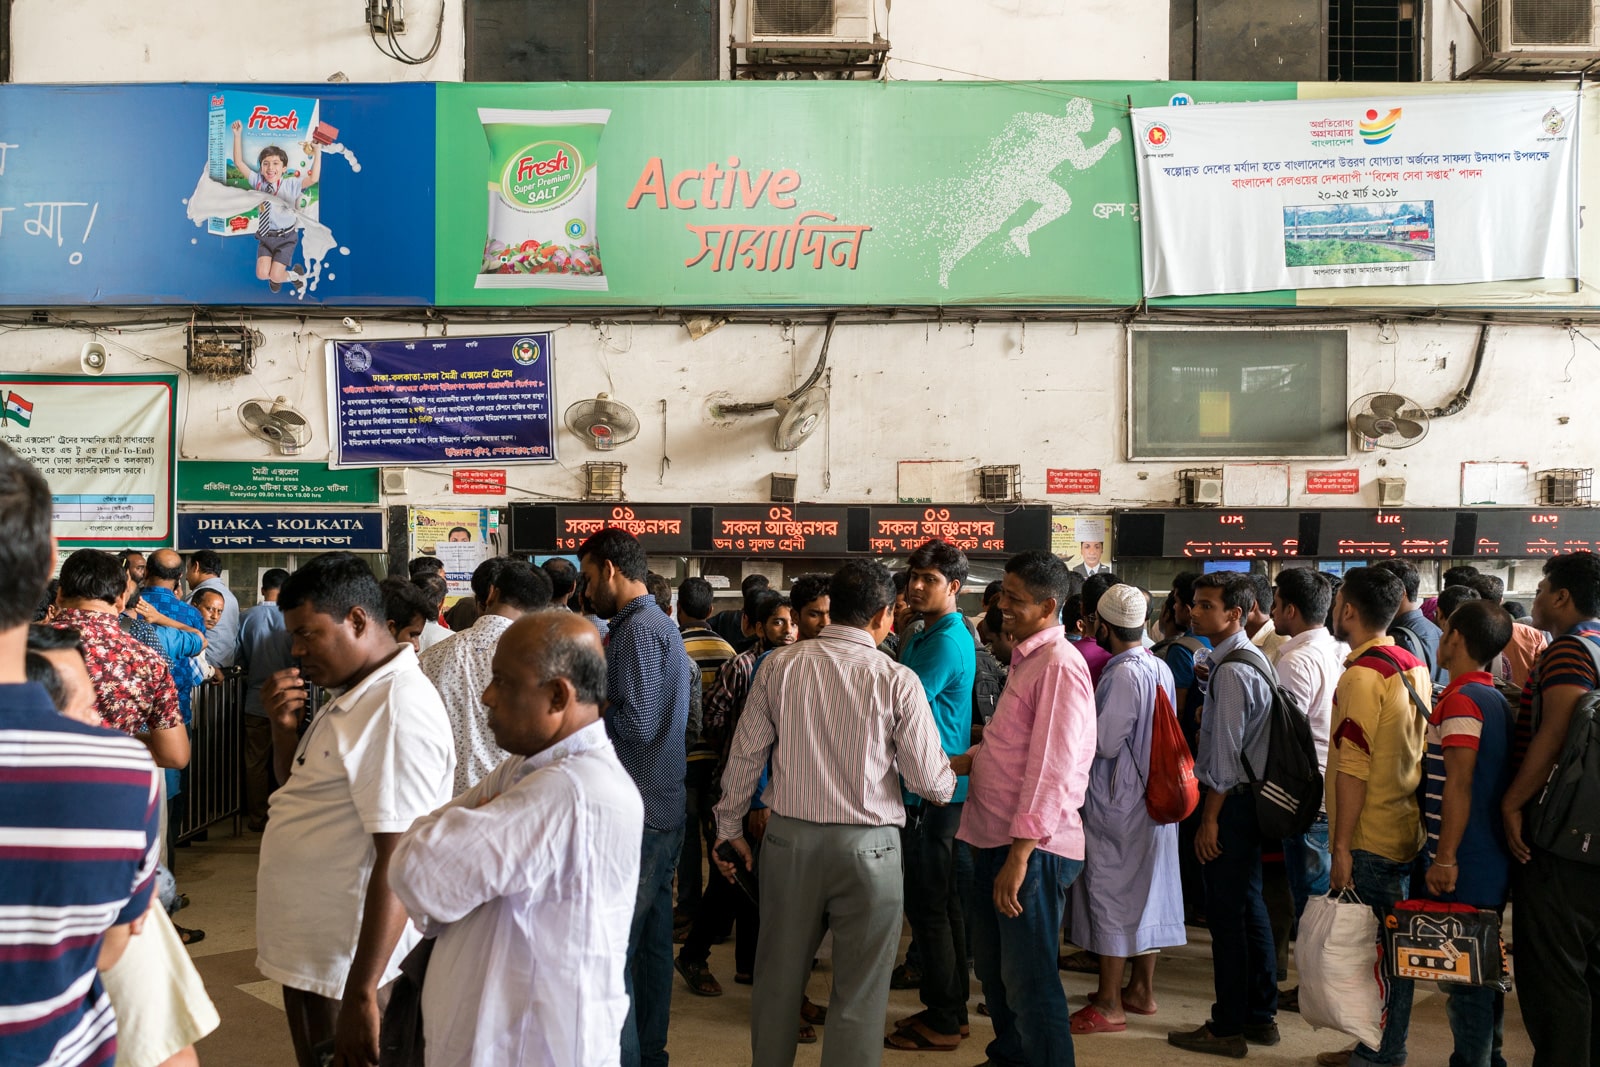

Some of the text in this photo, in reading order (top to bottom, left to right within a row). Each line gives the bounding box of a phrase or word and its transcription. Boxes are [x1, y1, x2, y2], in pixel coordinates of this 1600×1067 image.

[248, 105, 299, 131] Fresh
[1311, 138, 1354, 148] বাংলাদেশ
[517, 149, 568, 182] Fresh
[1203, 164, 1230, 175] দেশের
[1234, 161, 1259, 173] মর্যাদা
[1263, 161, 1281, 172] হতে
[1284, 159, 1335, 171] বাংলাদেশের
[1339, 157, 1365, 169] উত্তরণ
[1370, 156, 1403, 167] যোগ্যতা
[1407, 152, 1439, 165] অর্জনের
[1443, 154, 1471, 164] সাফল্য
[1474, 152, 1511, 163] উদযাপন
[1514, 150, 1550, 162] উপলক্ষে
[514, 174, 570, 194] Super Premium
[626, 155, 800, 209] Active
[1232, 177, 1273, 189] বাংলাদেশ
[1277, 175, 1317, 186] রেলওয়ের
[1322, 170, 1361, 185] দেশব্যাপী
[1403, 170, 1422, 181] সেবা
[1459, 169, 1483, 180] পালন
[528, 186, 559, 203] SALT
[1318, 186, 1398, 200] ২০-২৫ মার্চ ২০১৮
[1093, 203, 1125, 219] ফ্রেশ
[684, 210, 871, 271] সারাদিন
[58, 435, 78, 444] ট্রেনের
[80, 435, 106, 444] সম্মানিত
[108, 435, 122, 444] যাত্রী
[101, 447, 155, 455] (End-To-End)
[54, 457, 72, 465] (ঢাকা
[124, 457, 155, 465] কলকাতা)
[74, 466, 97, 474] সরাসরি
[252, 467, 268, 476] মৈত্রী
[203, 482, 231, 491] প্রতিদিন
[327, 484, 349, 492] ঘটিকা
[612, 507, 635, 520] ০১
[769, 507, 792, 521] ০২
[924, 508, 950, 521] ০৩
[198, 519, 364, 530] DHAKA KOLKATA
[566, 520, 605, 534] সকল
[722, 521, 839, 536] সকল আন্তঃনগর
[878, 521, 995, 537] সকল আন্তঃনগর
[209, 536, 352, 545] ঢাকা কলকাতা
[566, 538, 576, 549] ও
[735, 539, 745, 549] ও
[749, 539, 775, 552] সুলভ
